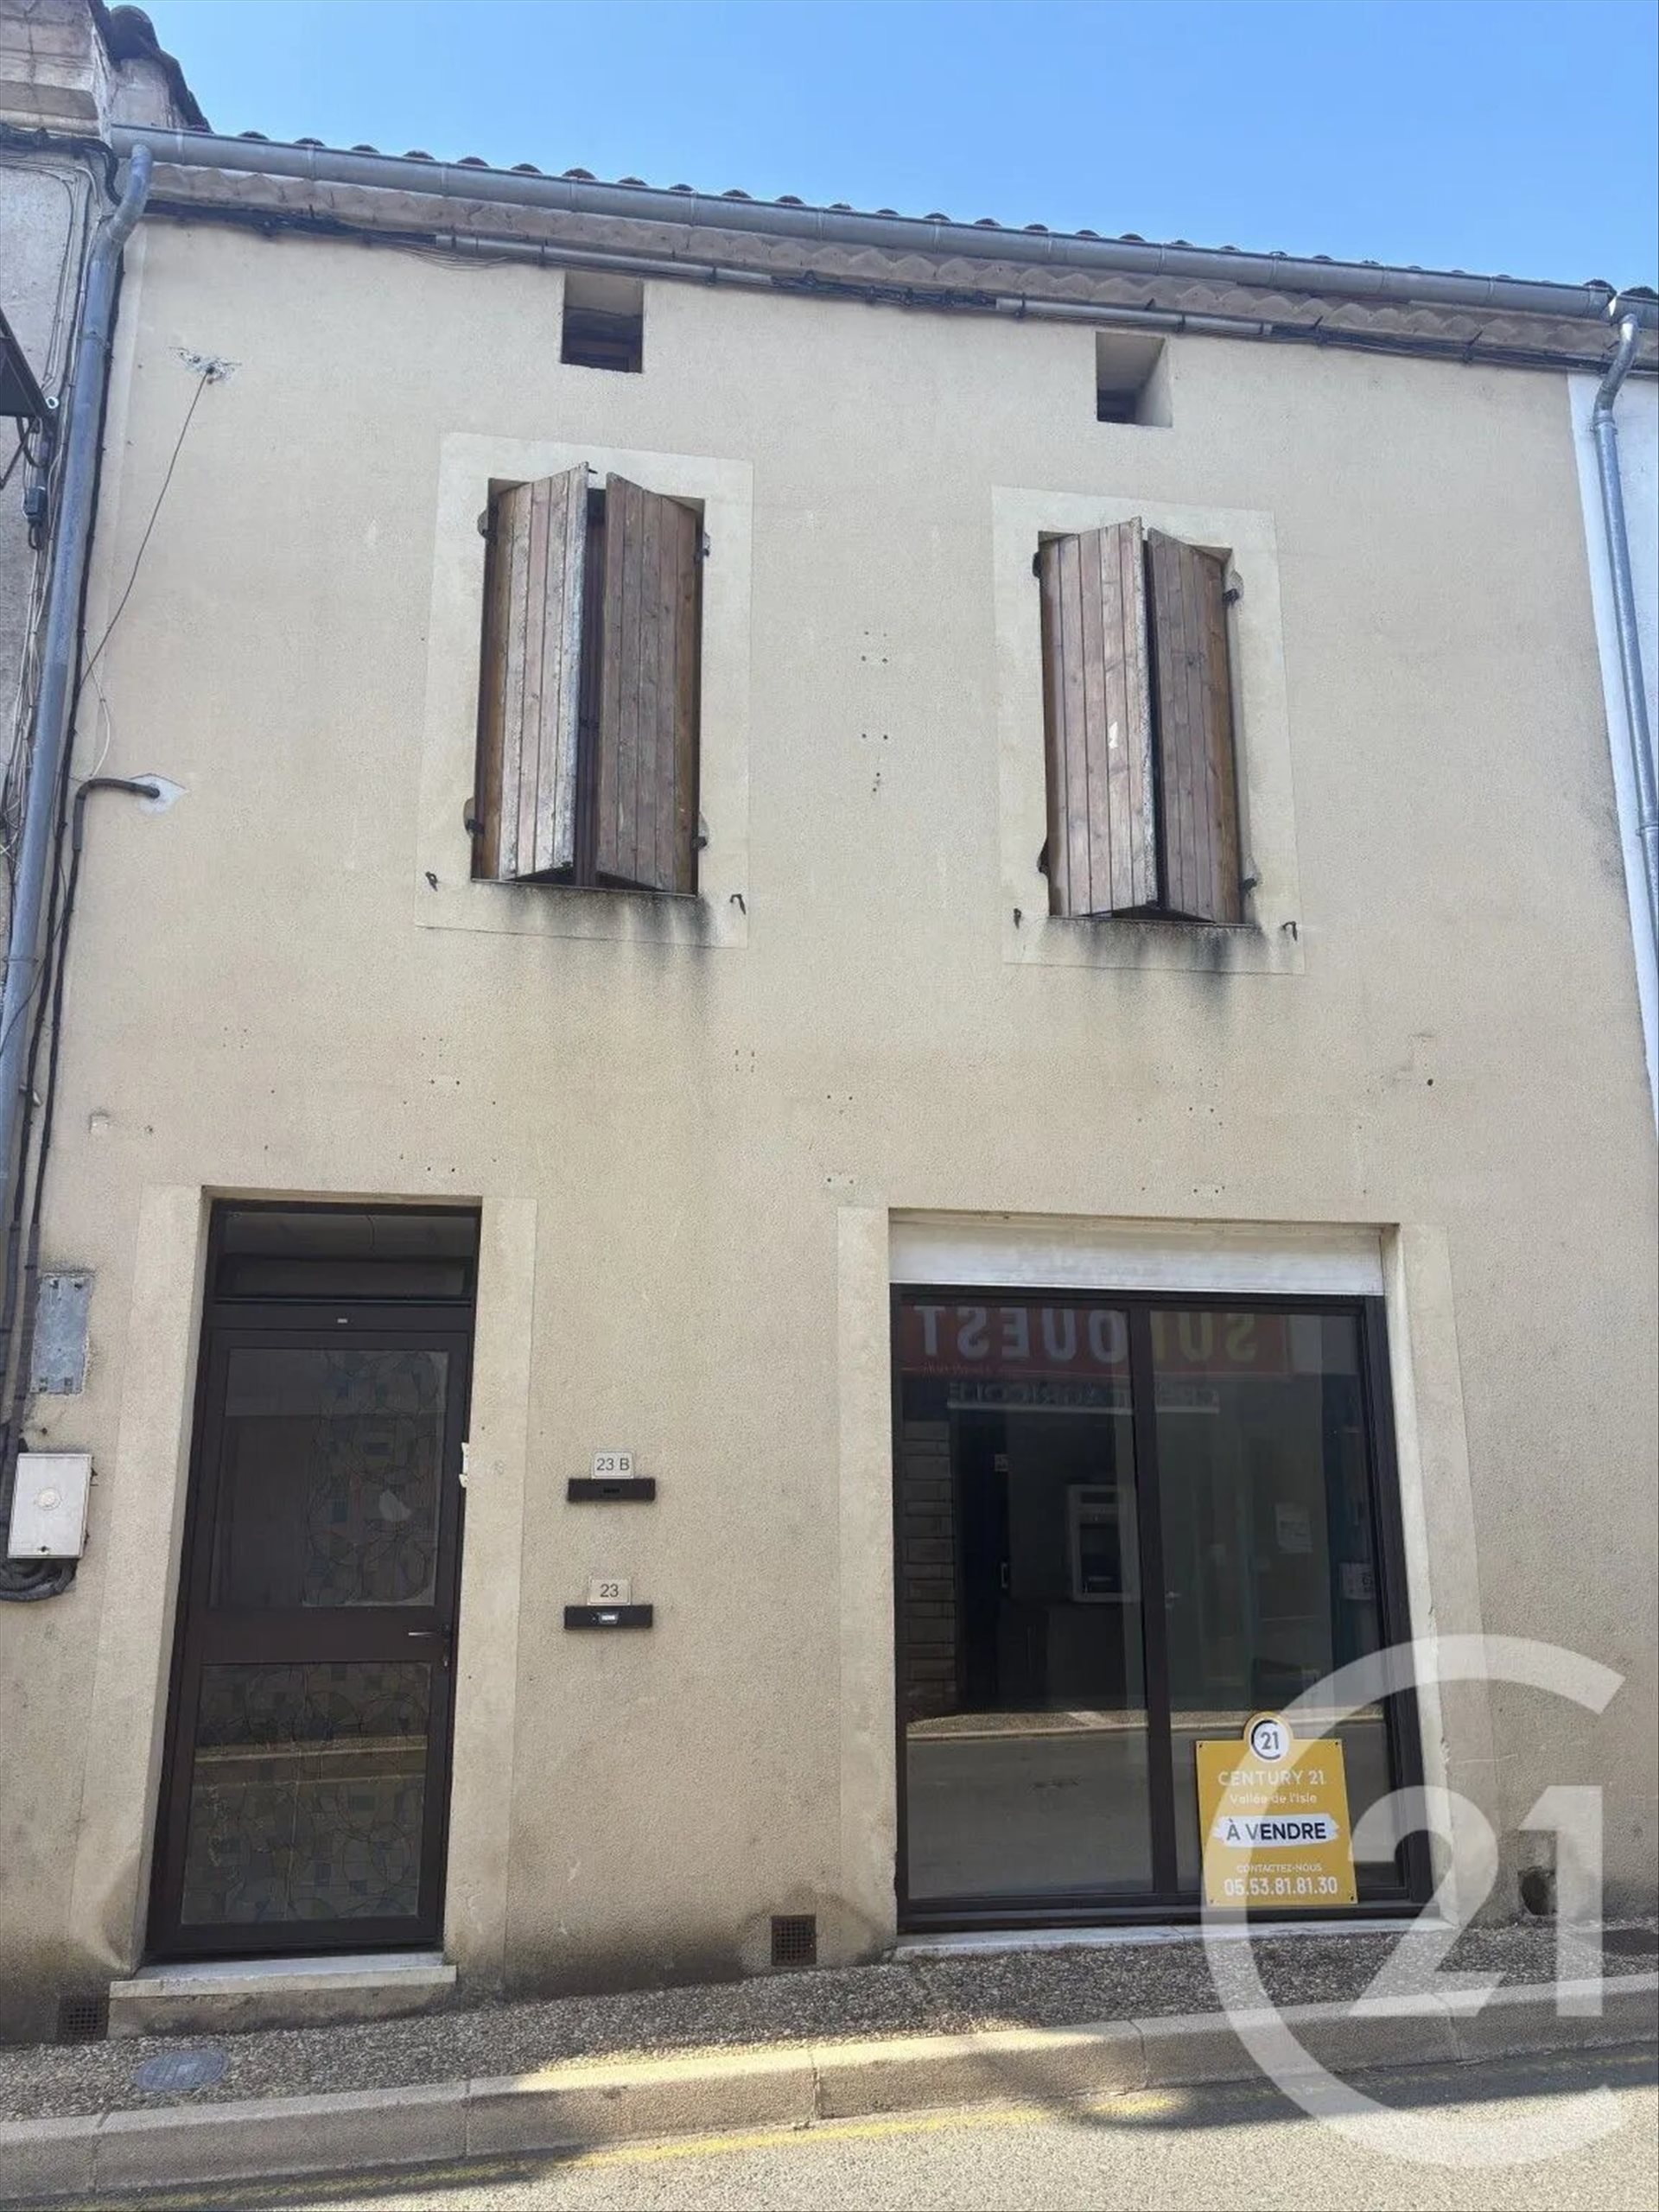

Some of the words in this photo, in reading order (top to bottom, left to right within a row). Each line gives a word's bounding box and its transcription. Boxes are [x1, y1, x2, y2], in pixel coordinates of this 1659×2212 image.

[596, 1459, 613, 1471] 23
[620, 1459, 630, 1470] B
[600, 1584, 619, 1598] 23
[1260, 1732, 1280, 1750] 21
[1218, 1770, 1301, 1786] CENTURY
[1308, 1770, 1325, 1784] 21
[1230, 1794, 1268, 1804] Vallée
[1271, 1794, 1287, 1803] de
[1226, 1818, 1241, 1840] À
[1245, 1822, 1326, 1840] VENDRE
[1236, 1863, 1322, 1873] CONTACTEZ-NOUS
[1224, 1877, 1338, 1897] 05.53.81.81.30
